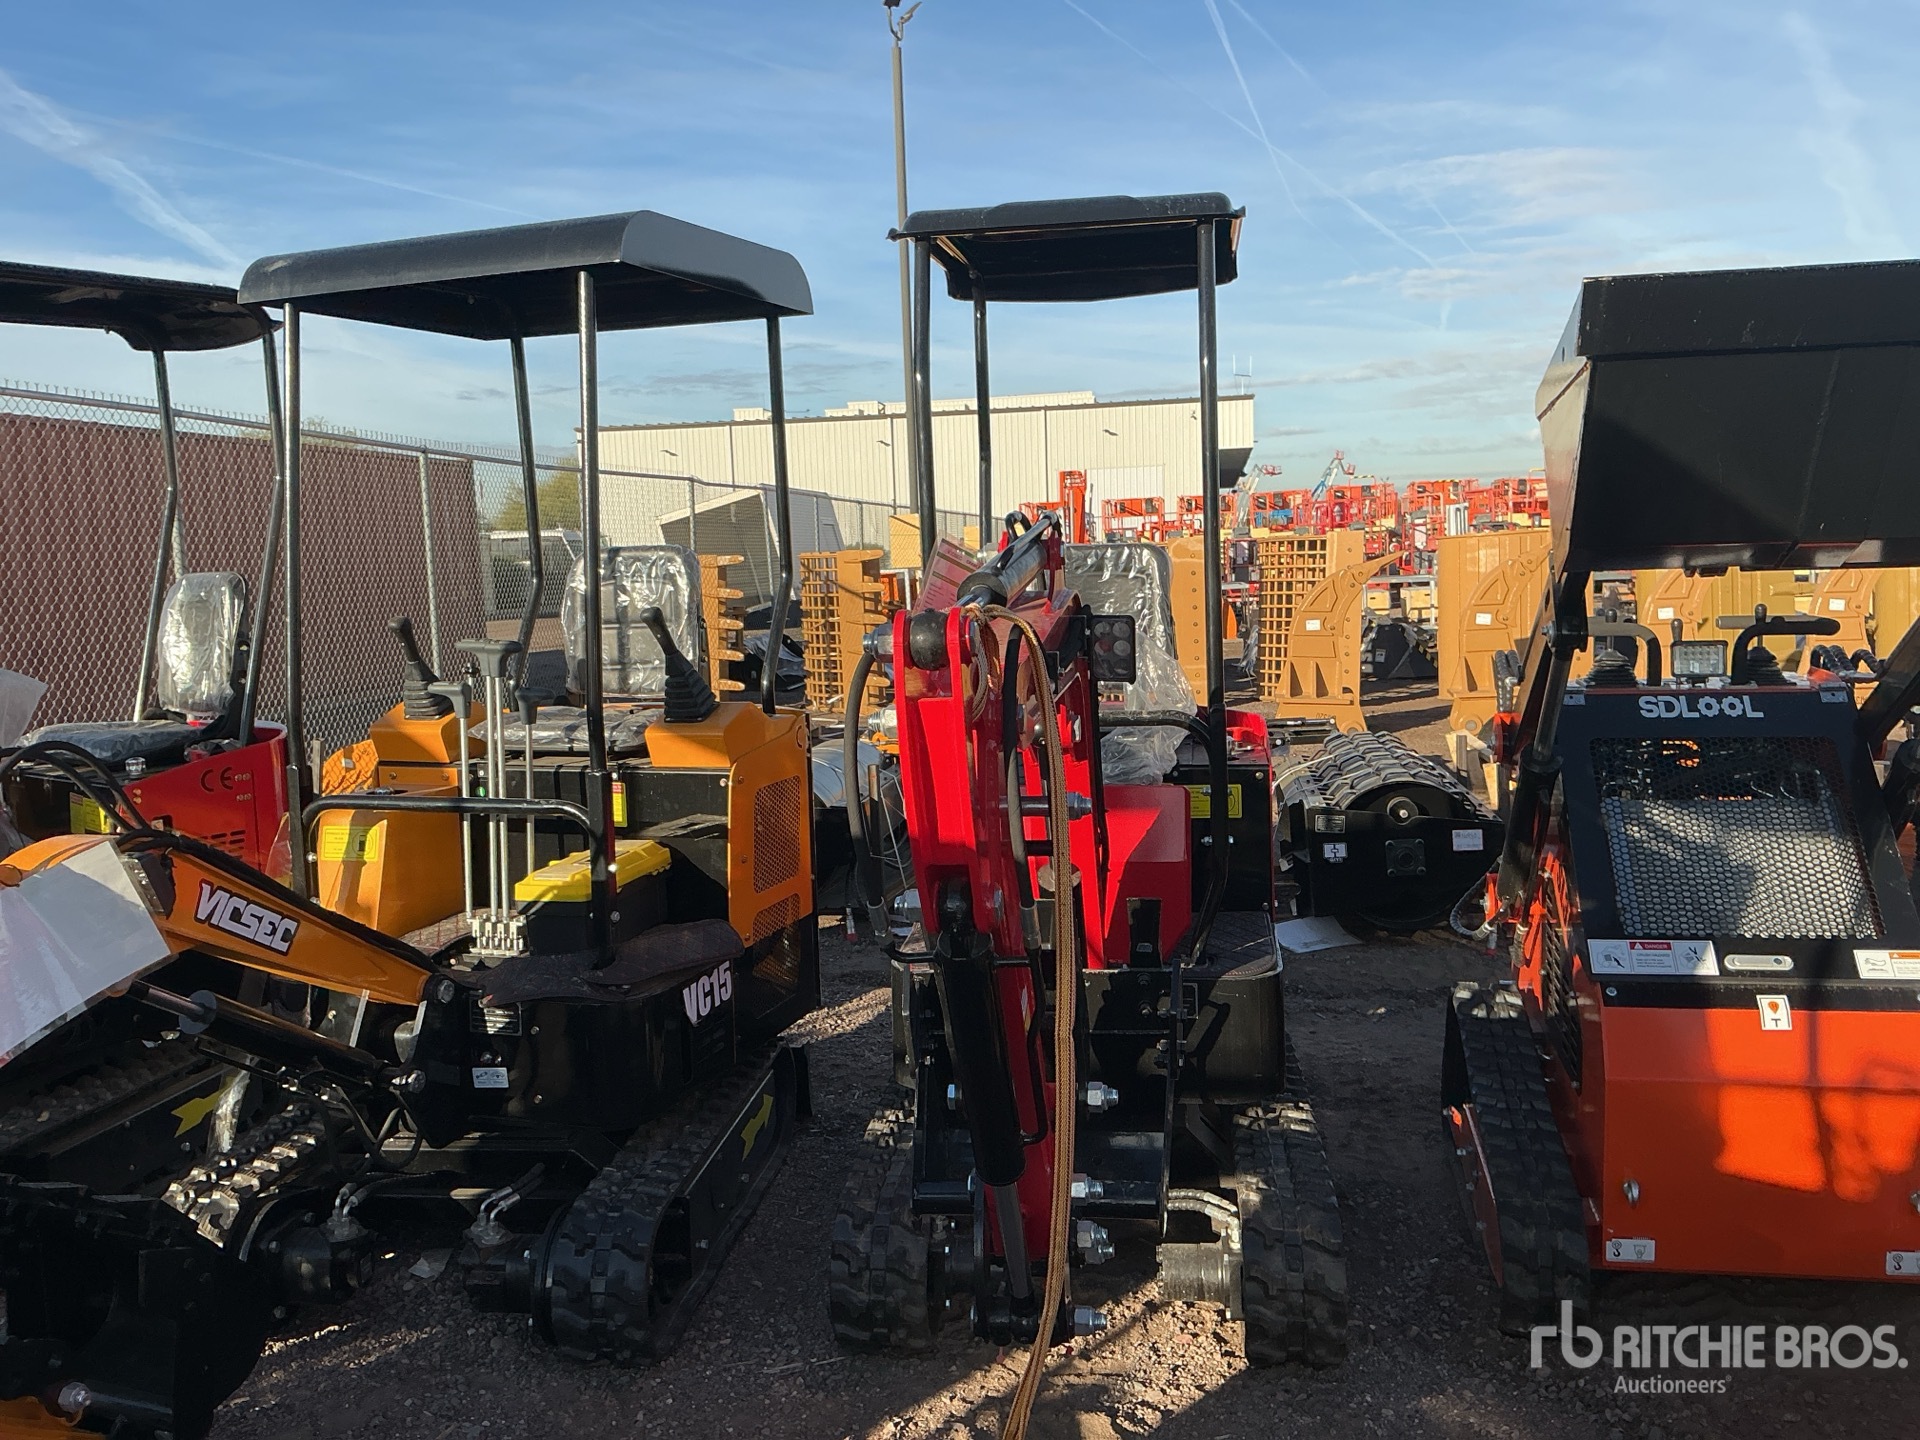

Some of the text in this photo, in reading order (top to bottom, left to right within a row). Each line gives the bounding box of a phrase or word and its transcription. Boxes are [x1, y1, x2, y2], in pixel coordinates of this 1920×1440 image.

[1638, 695, 1764, 718] SDLOOL
[200, 766, 234, 793] CE
[195, 880, 299, 954] VICSEC
[682, 960, 732, 1024] VC15
[1771, 1018, 1781, 1027] T
